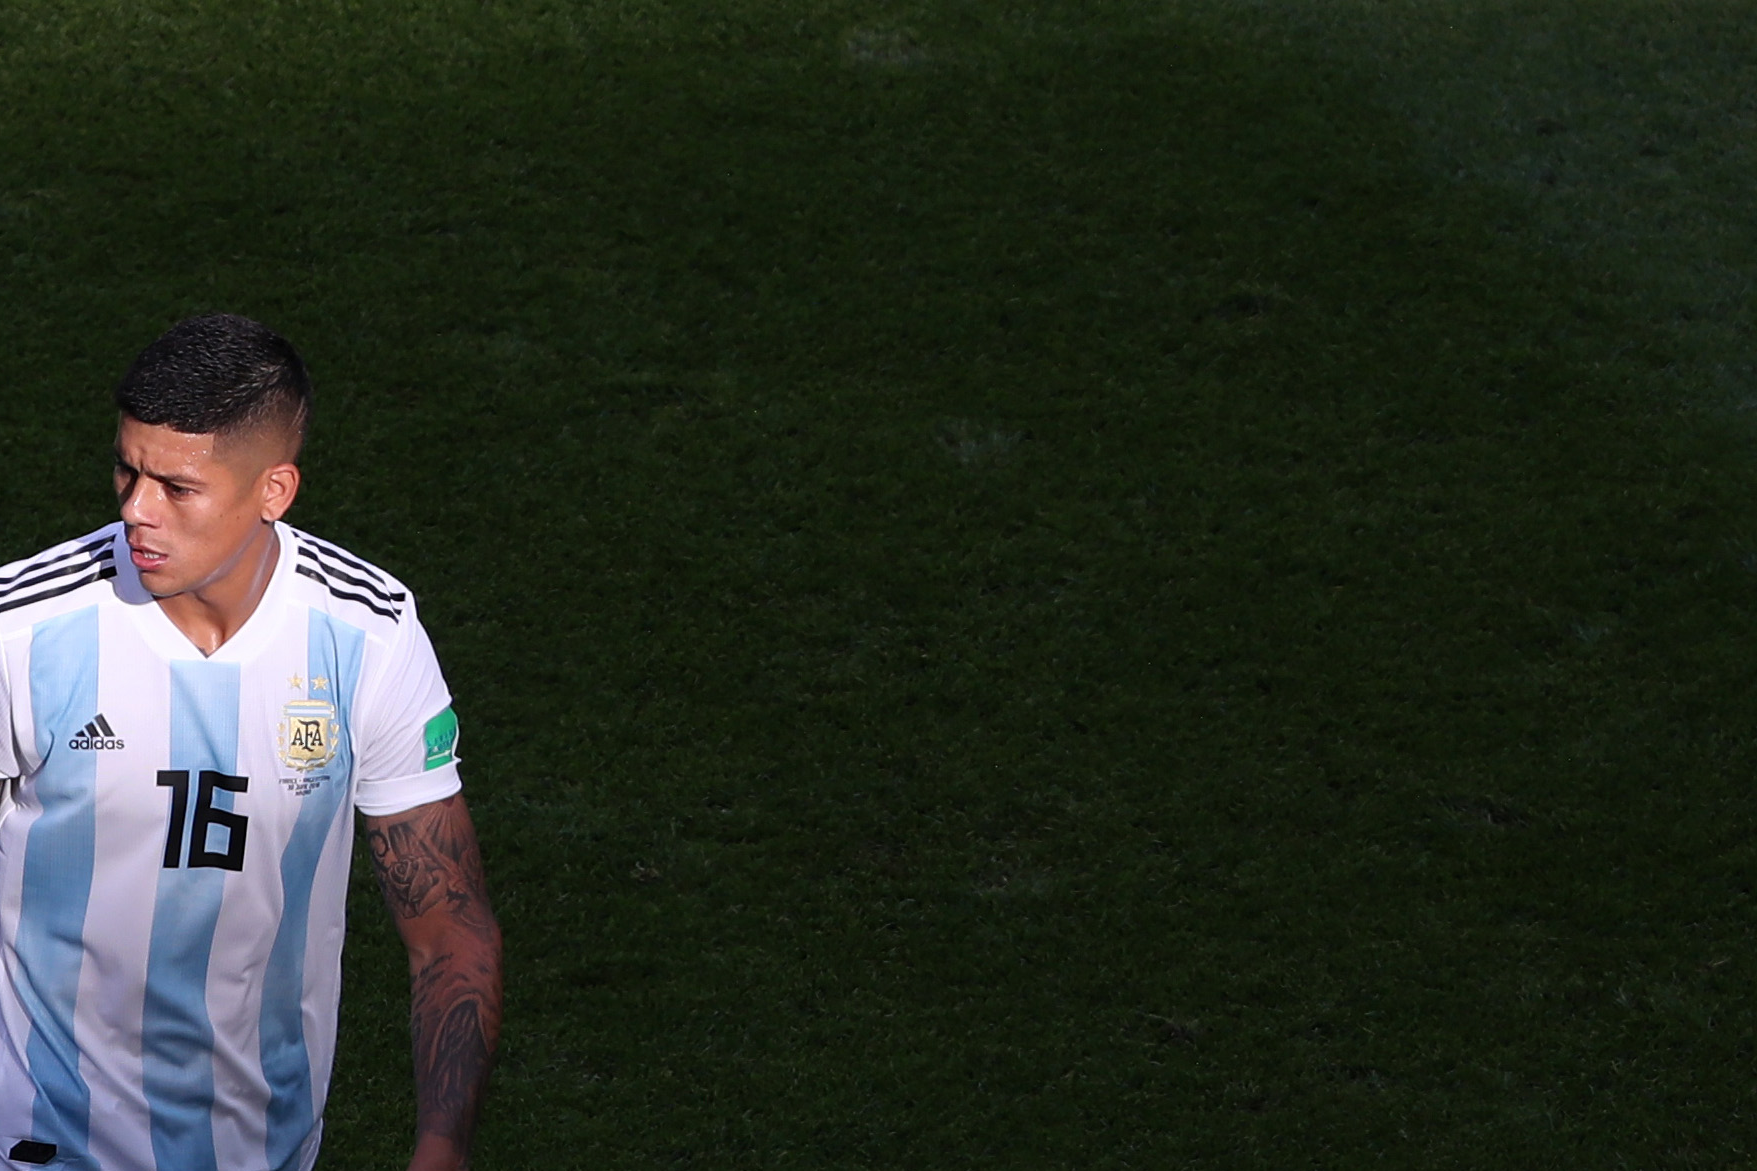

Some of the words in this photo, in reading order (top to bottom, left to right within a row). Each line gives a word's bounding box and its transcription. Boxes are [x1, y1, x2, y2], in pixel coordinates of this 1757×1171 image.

[68, 736, 125, 750] adidas
[291, 719, 323, 752] AFA
[156, 770, 249, 872] 16
